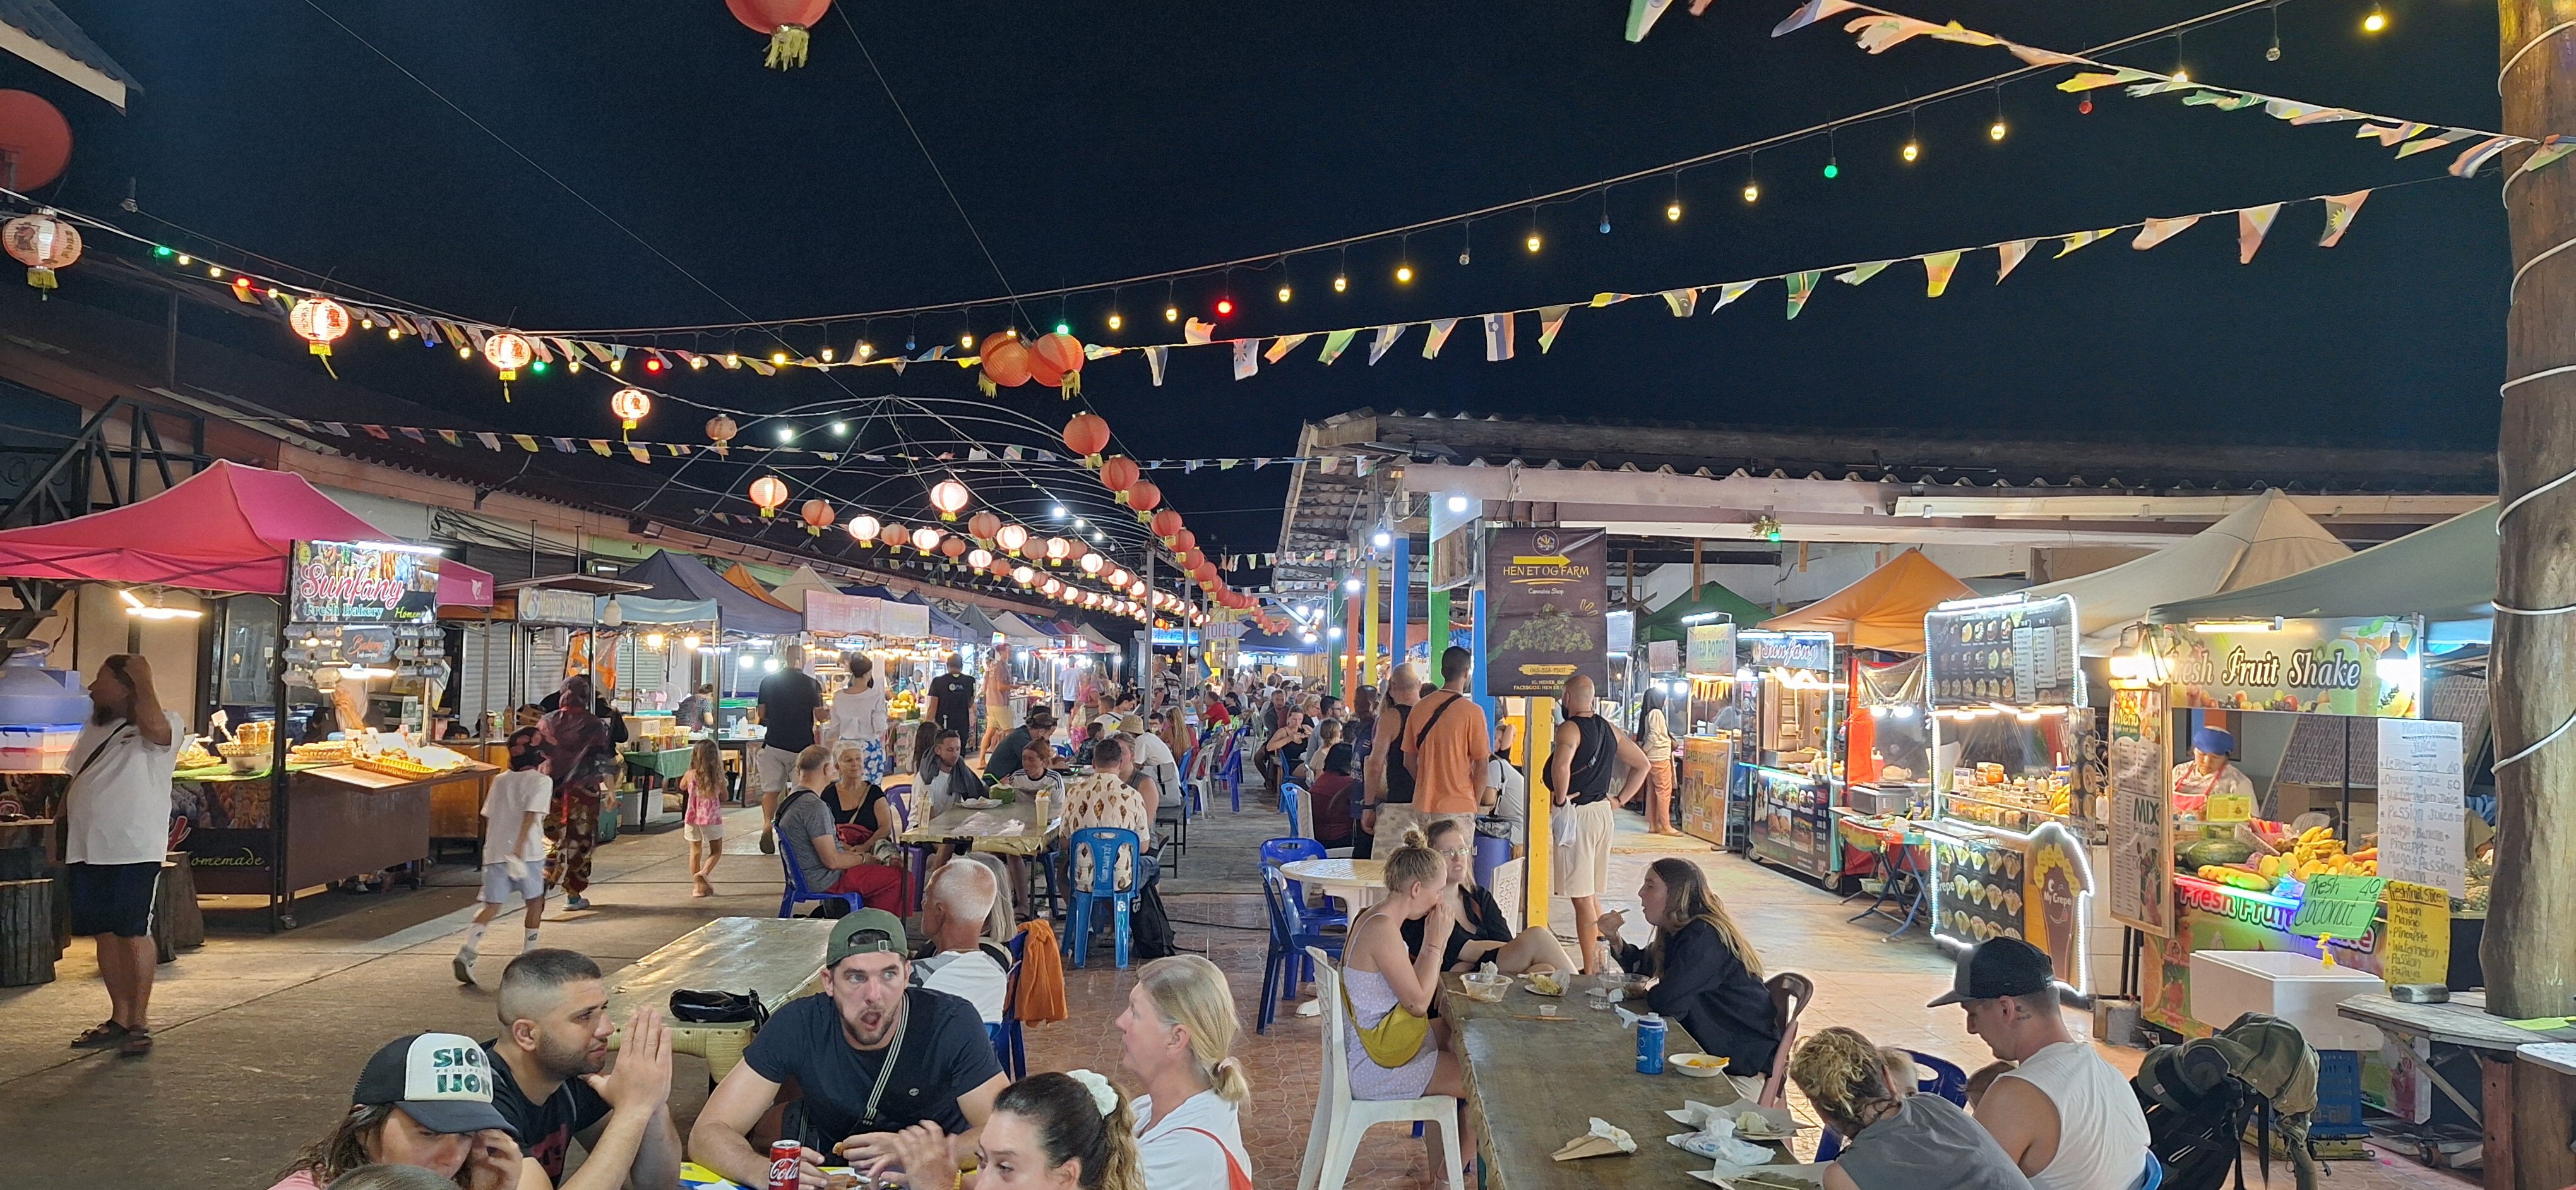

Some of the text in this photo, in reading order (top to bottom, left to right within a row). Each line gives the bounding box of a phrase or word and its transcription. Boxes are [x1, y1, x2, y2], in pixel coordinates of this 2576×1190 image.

[1503, 565, 1589, 578] HEN ET OG FARM
[301, 563, 405, 610] Sunfany
[304, 602, 383, 620] Fresh Bakery
[1207, 622, 1238, 638] TOILET
[347, 634, 384, 656] Bakery
[1707, 639, 1729, 658] POTATO
[1762, 639, 1818, 666] Sunfany
[2222, 645, 2281, 687] Fruit
[2287, 648, 2361, 688] Shake
[2114, 708, 2139, 727] Menu
[2133, 797, 2159, 827] MIX
[189, 847, 265, 867] omemade
[2359, 878, 2381, 896] 40
[2044, 891, 2072, 908] My Crepe
